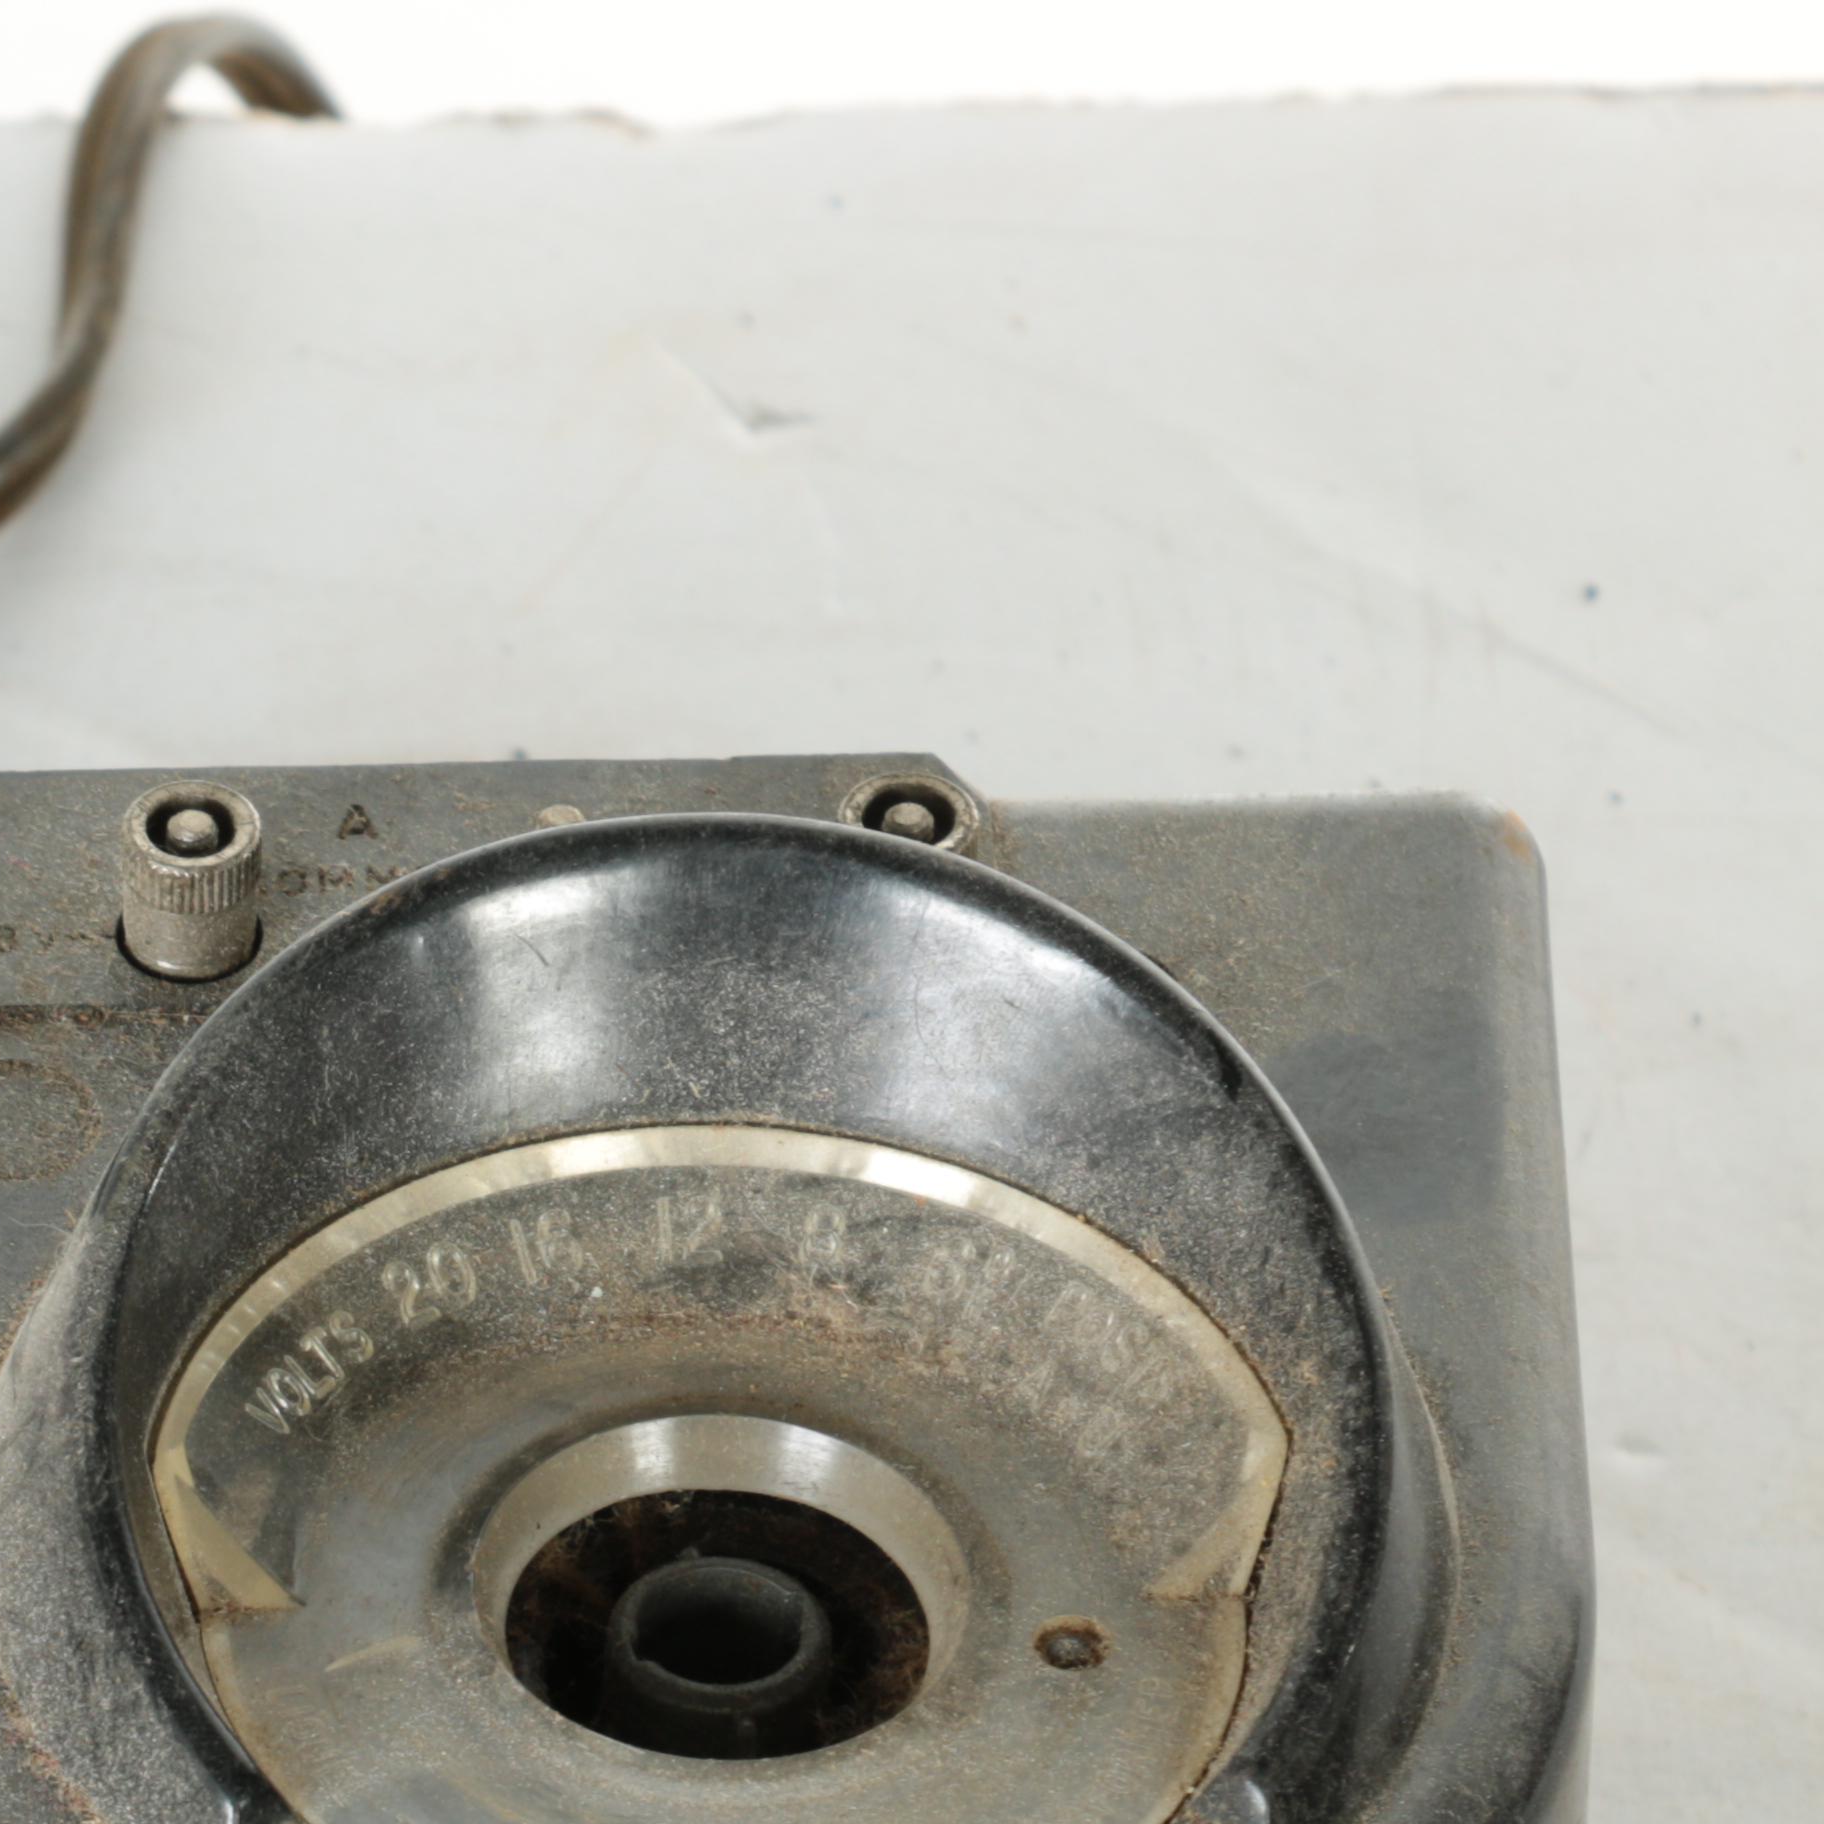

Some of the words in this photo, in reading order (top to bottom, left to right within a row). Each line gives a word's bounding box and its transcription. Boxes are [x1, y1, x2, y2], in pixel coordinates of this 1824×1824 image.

[337, 803, 379, 841] A
[244, 1309, 375, 1436] VOLTS
[380, 1241, 478, 1331] 20
